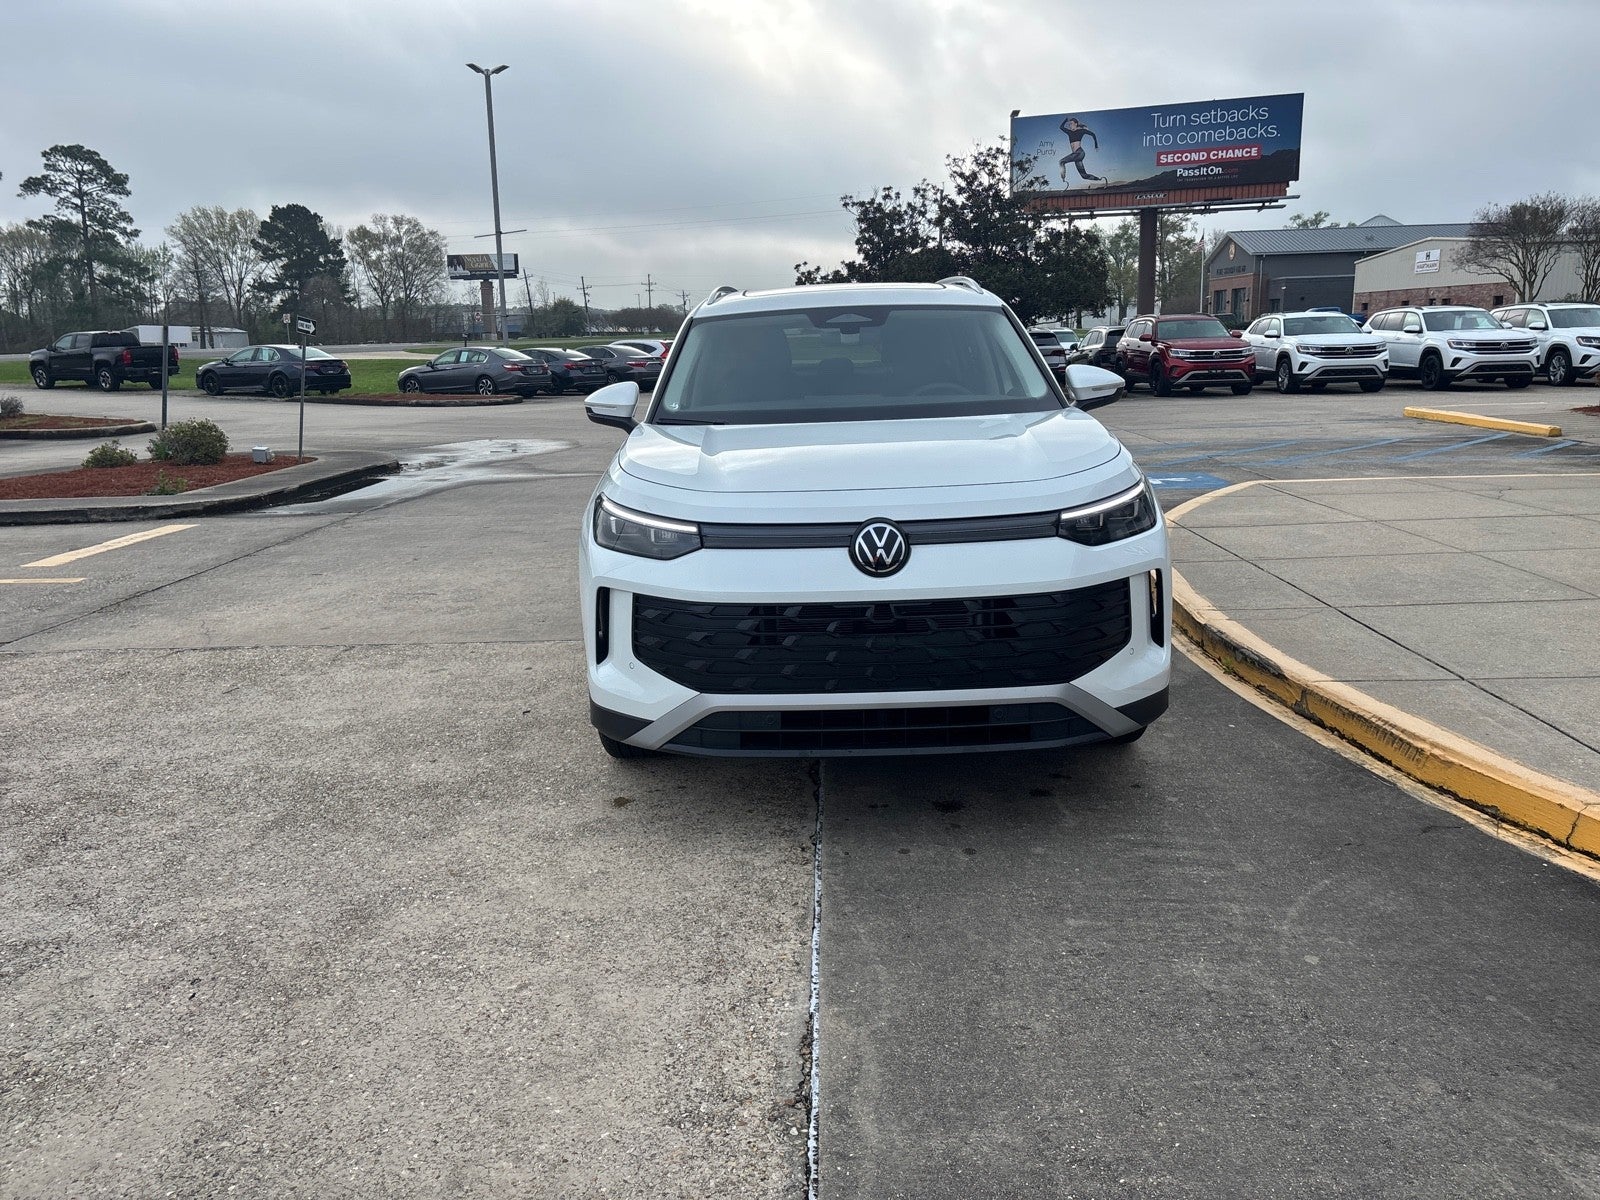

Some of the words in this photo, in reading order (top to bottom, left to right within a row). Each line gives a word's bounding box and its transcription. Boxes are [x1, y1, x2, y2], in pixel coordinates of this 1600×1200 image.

[1151, 112, 1187, 129] Turn
[1190, 104, 1269, 126] setbacks
[1039, 140, 1054, 148] Amy
[1142, 131, 1173, 147] into
[1176, 122, 1281, 145] comebacks.
[1159, 152, 1207, 164] SECOND
[1209, 147, 1259, 161] CHANCE
[855, 522, 906, 573] VW
